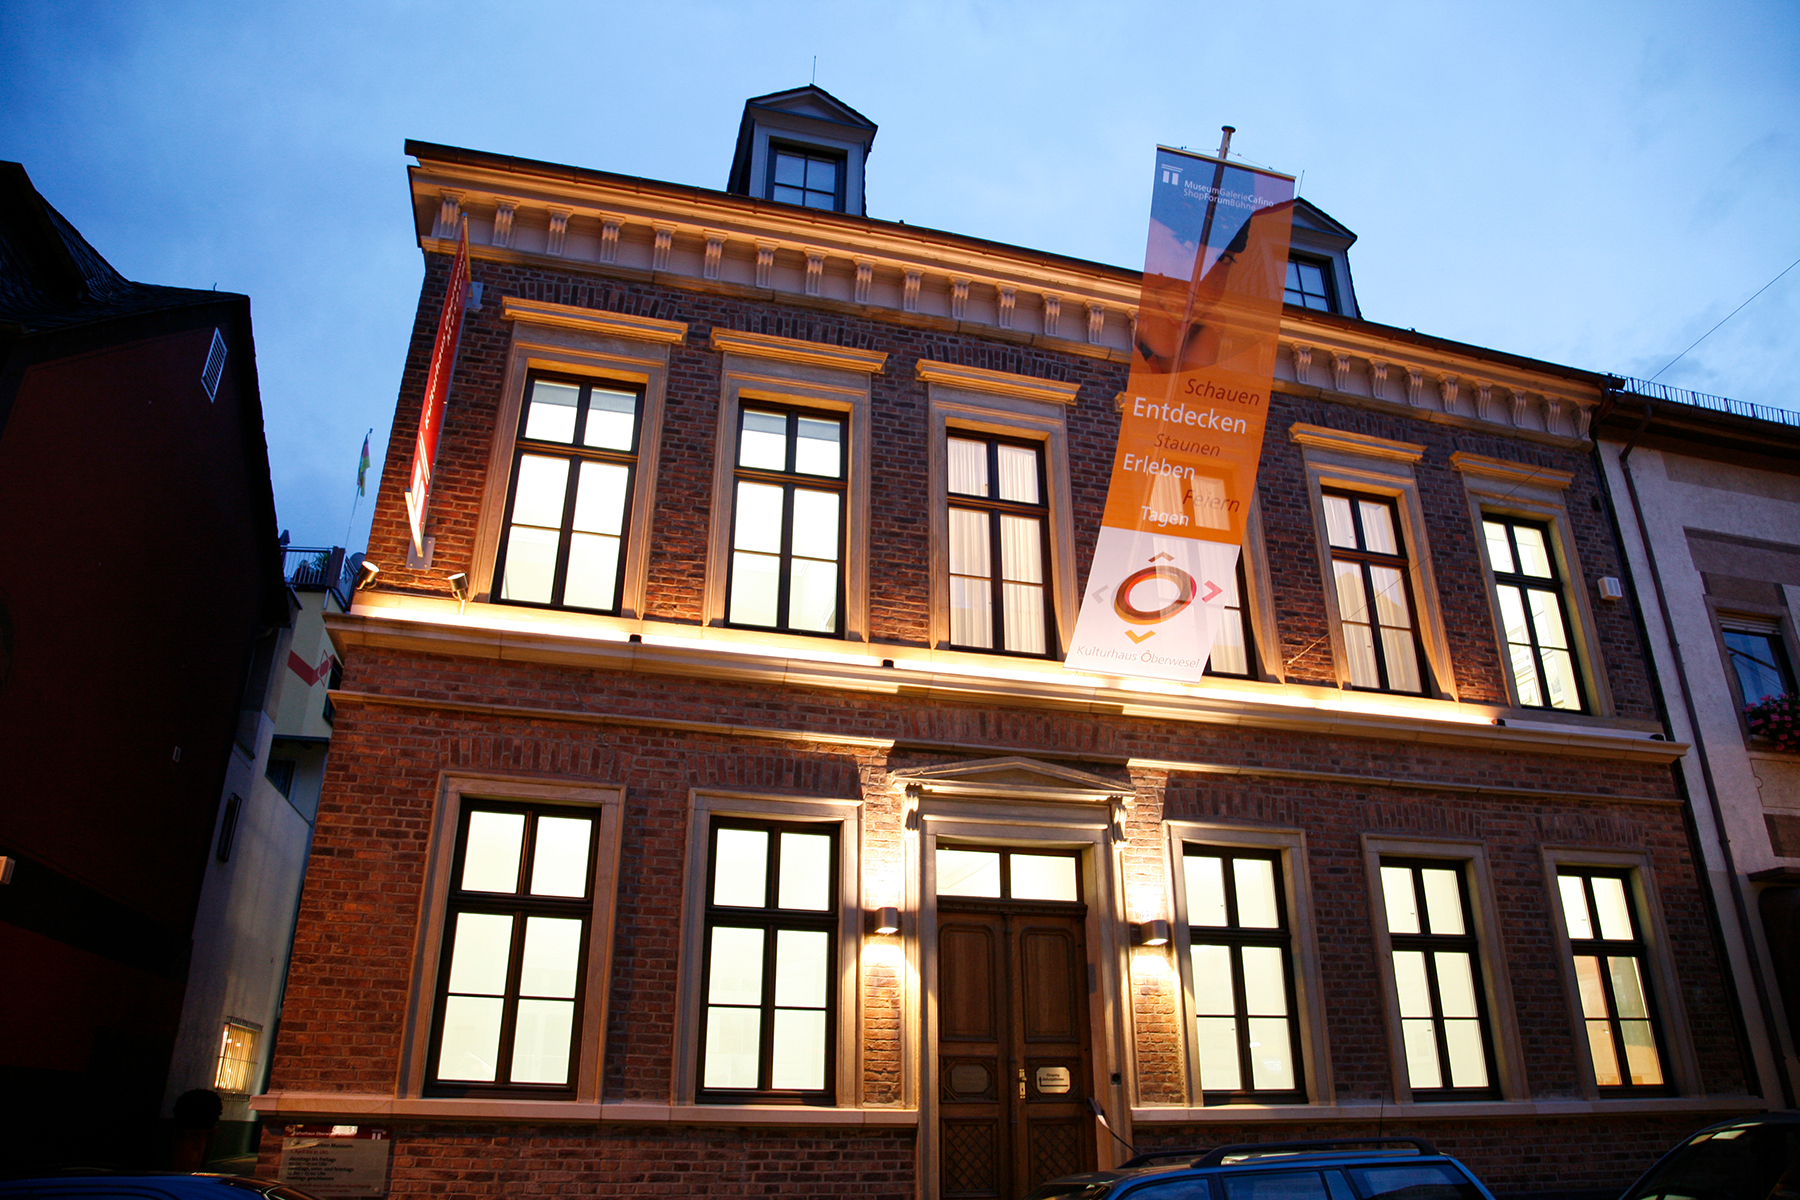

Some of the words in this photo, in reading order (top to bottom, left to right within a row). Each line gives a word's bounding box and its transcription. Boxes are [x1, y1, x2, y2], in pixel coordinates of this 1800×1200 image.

[1185, 378, 1260, 406] Schauen
[1132, 396, 1247, 435] Entdecken
[1153, 433, 1221, 457] Staunen
[1122, 453, 1196, 480] Erleben
[1182, 489, 1240, 513] Feiern
[1141, 505, 1190, 527] Tagen
[1076, 645, 1138, 661] Kulturhaus
